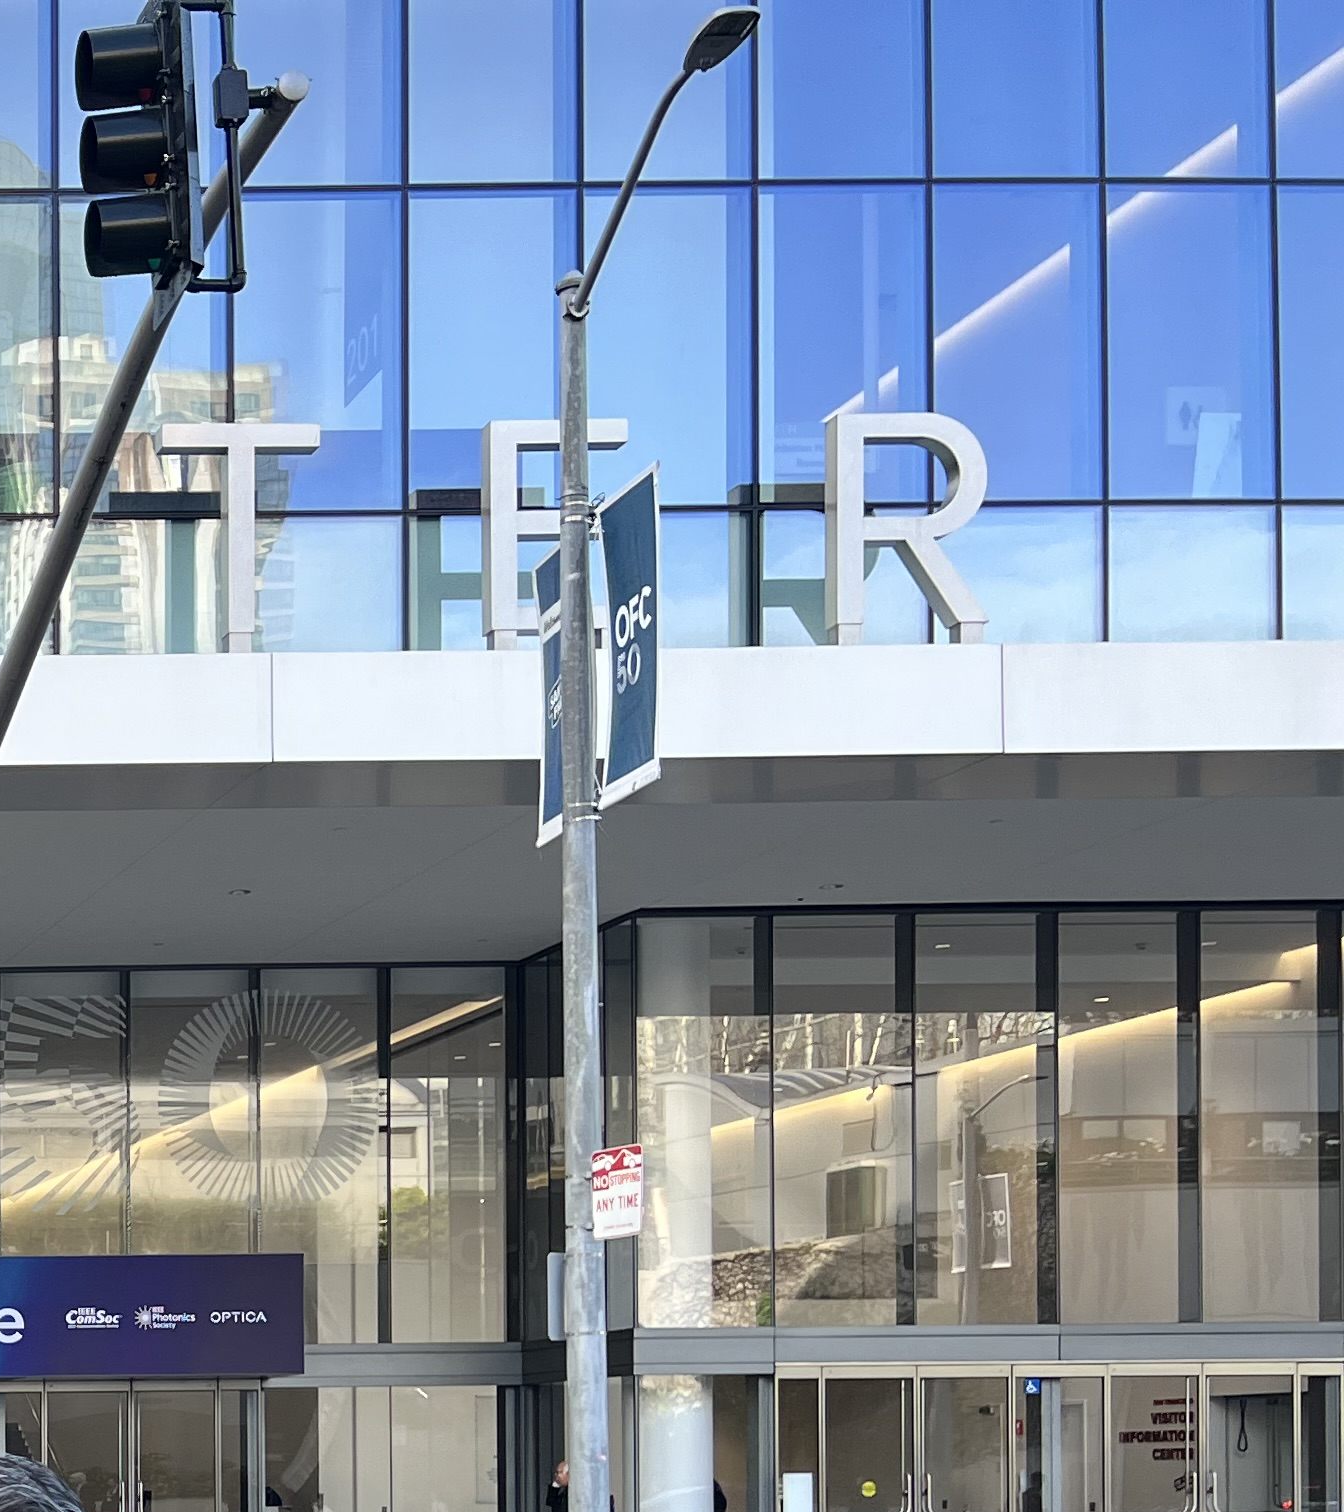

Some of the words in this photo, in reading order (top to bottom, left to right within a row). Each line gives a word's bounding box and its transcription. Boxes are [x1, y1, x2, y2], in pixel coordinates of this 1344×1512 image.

[614, 585, 653, 649] OFC
[615, 642, 642, 695] 50
[593, 1175, 609, 1189] NO
[609, 1171, 641, 1187] STOPPING
[596, 1196, 614, 1212] ANY
[618, 1193, 639, 1209] TIME
[65, 1309, 120, 1324] ComSoc
[152, 1312, 196, 1323] Photonics
[210, 1310, 268, 1324] OPTICA
